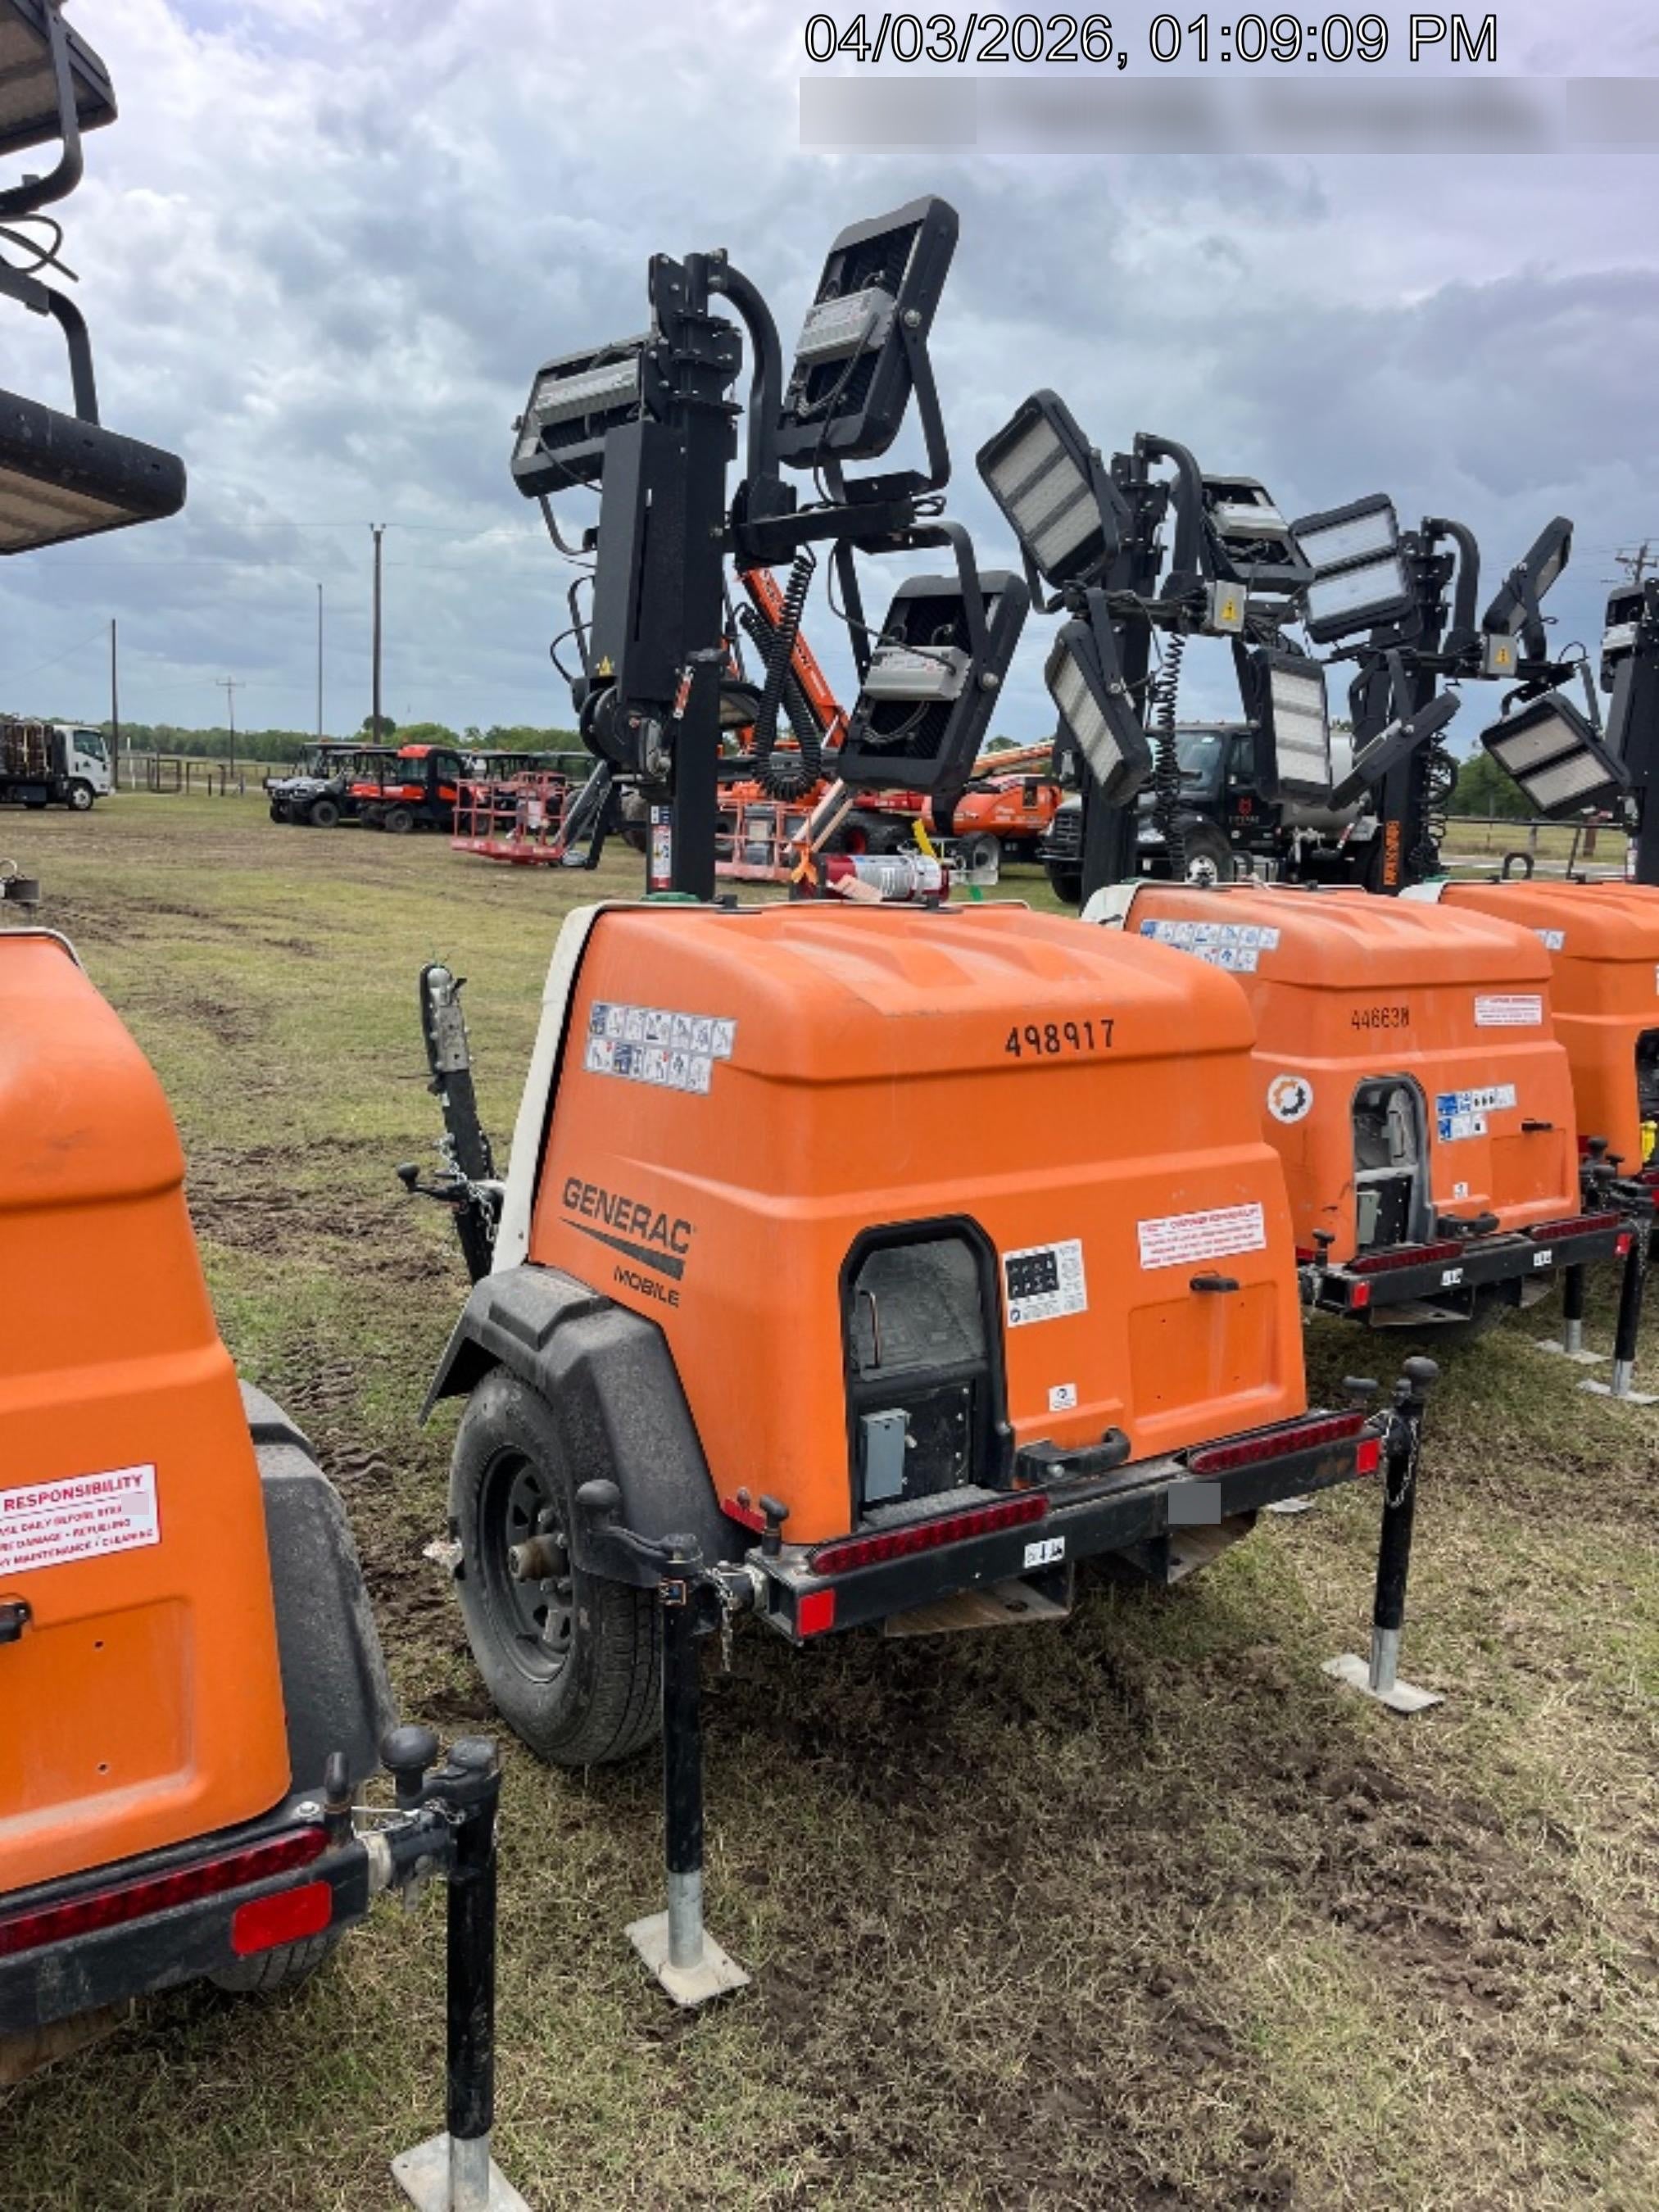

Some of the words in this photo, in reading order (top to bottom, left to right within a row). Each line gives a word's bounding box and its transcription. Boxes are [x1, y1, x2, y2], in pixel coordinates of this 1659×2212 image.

[1005, 1018, 1114, 1057] 498917
[563, 1176, 691, 1253] GENERAC
[614, 1265, 680, 1308] MOBILE
[3, 1475, 143, 1512] RESPONSIBILITY
